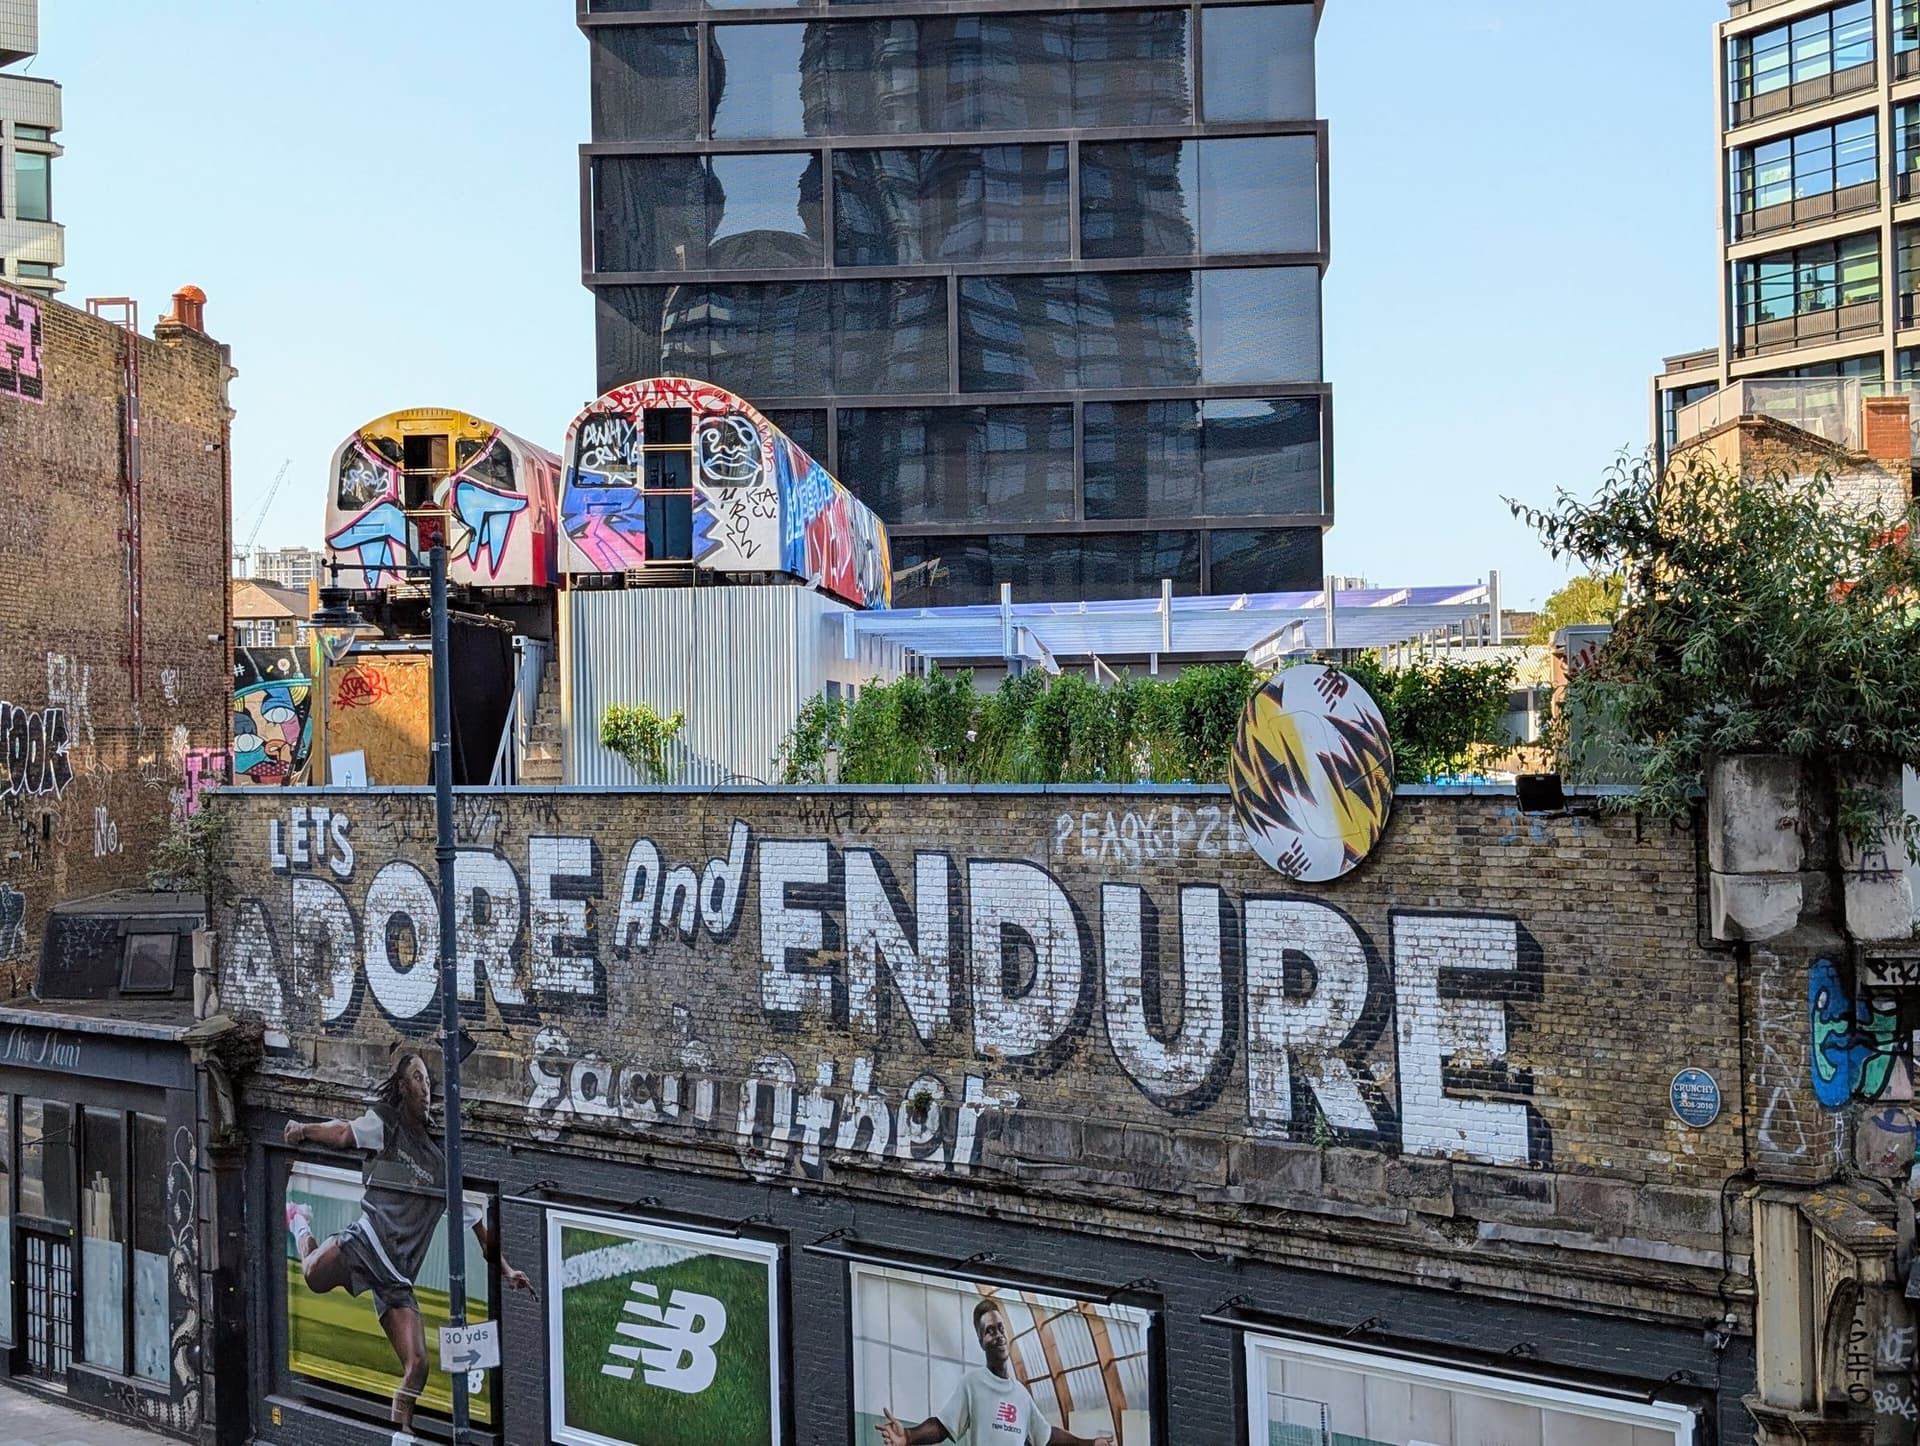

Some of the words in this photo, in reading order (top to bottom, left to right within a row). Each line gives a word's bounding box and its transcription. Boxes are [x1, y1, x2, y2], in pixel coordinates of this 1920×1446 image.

[270, 805, 356, 882] LETS
[220, 836, 607, 1056] ADORE
[613, 817, 752, 962] And
[757, 837, 1553, 1171] ENDURE
[736, 1044, 1024, 1186] Other
[1673, 1082, 1715, 1094] CRUNCHY
[445, 1332, 462, 1344] 30
[466, 1329, 488, 1344] yds
